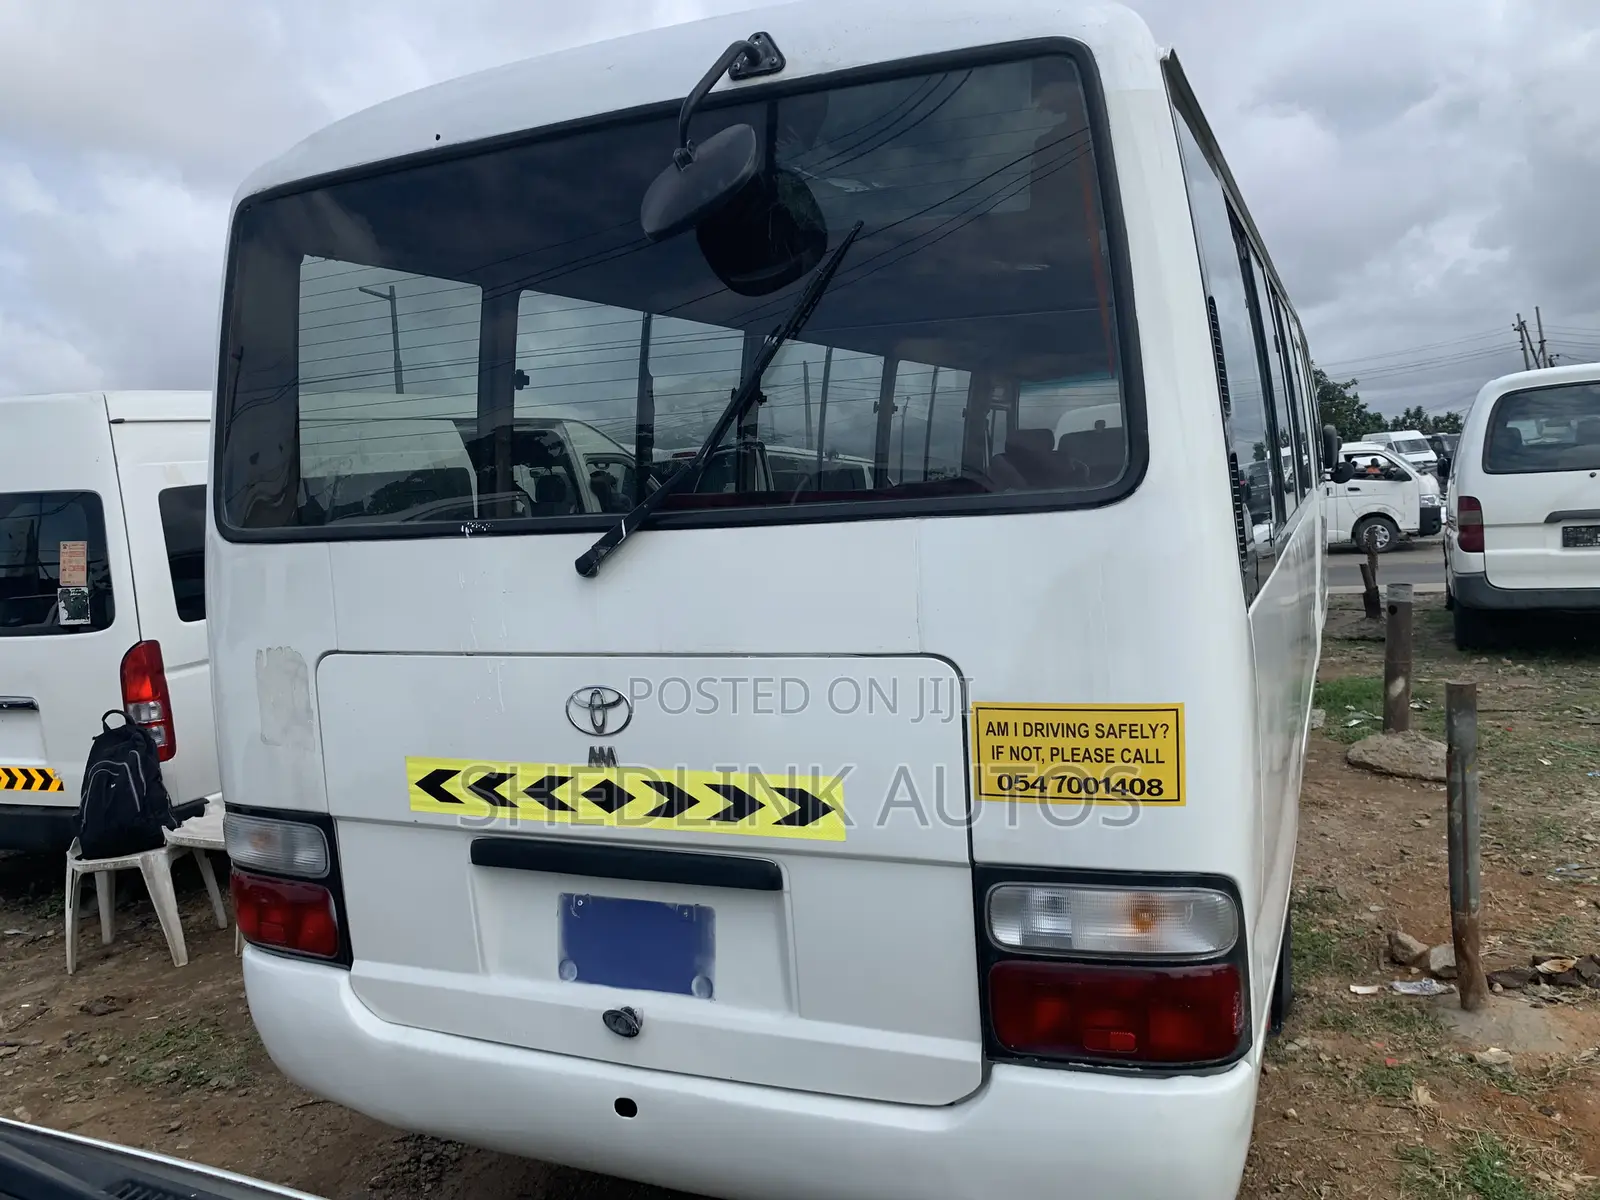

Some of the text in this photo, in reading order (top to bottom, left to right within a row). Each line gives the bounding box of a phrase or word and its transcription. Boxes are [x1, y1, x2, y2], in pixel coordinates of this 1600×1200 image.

[985, 721, 1170, 740] AM I DRIVING SAFELY?
[991, 744, 1166, 765] IF NOT, PLEASE CALL
